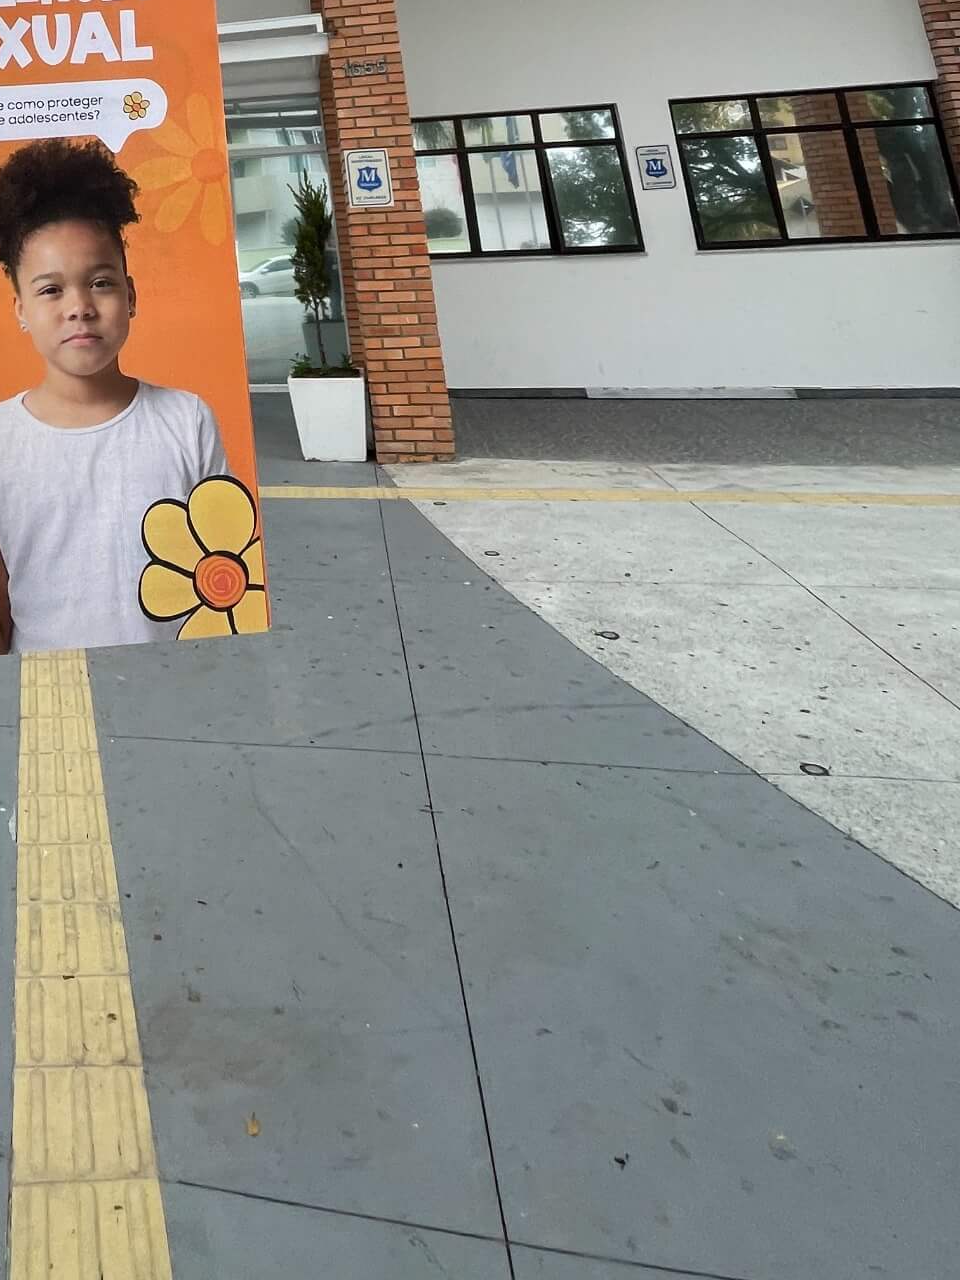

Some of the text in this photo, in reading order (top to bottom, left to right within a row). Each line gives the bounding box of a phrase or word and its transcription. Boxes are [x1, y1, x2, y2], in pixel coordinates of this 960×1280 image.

[7, 99, 45, 111] como
[47, 96, 104, 111] proteger
[8, 109, 100, 125] adolescentes?
[361, 169, 376, 182] M
